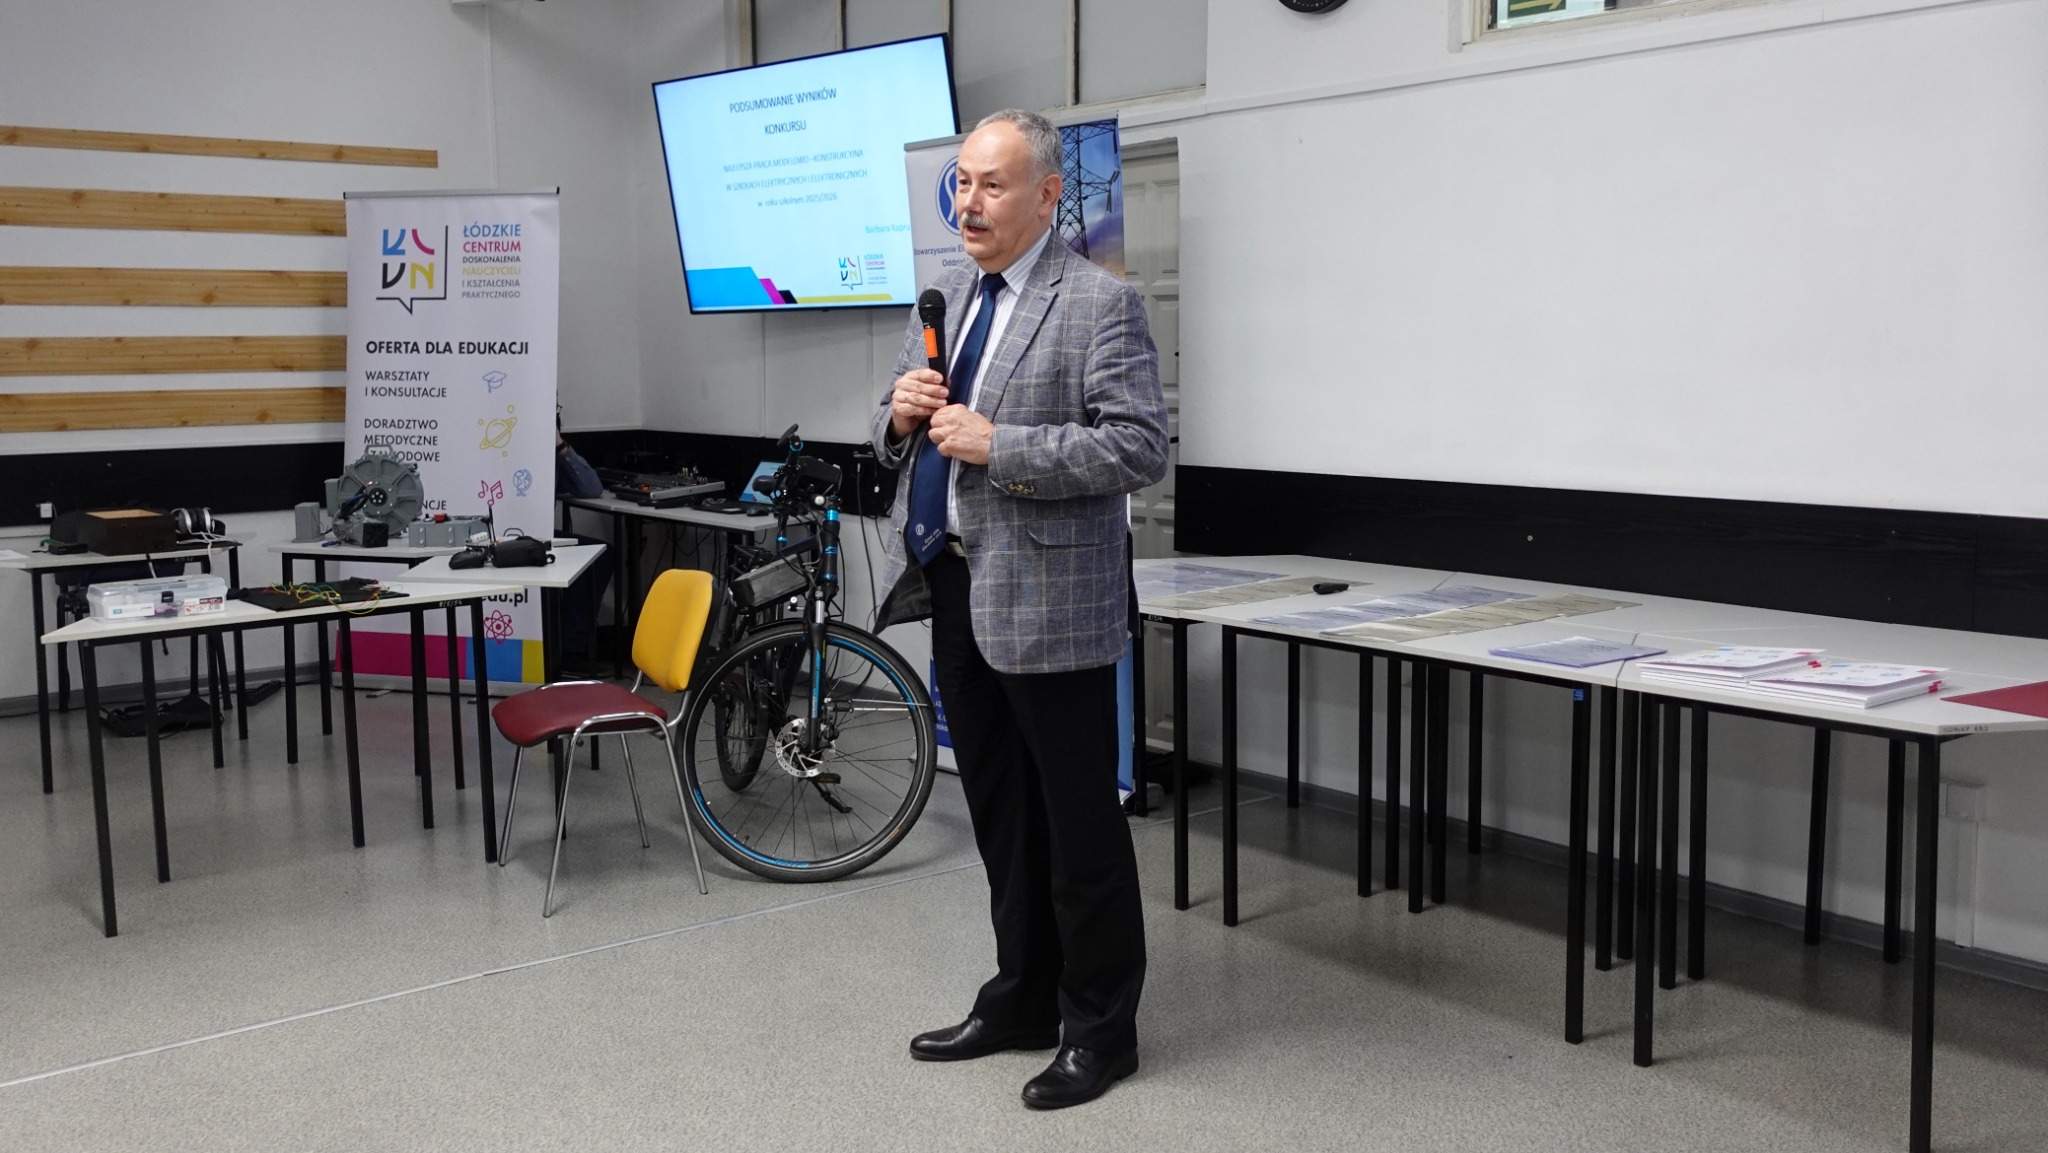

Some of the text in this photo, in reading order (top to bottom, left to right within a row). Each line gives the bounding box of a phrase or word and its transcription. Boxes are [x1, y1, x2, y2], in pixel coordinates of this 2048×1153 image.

[729, 86, 837, 113] PODSUMOWANIE WYNIKÓW
[764, 120, 807, 135] KONKURSU
[753, 159, 772, 170] PRACA
[773, 155, 809, 167] MODELOWO
[761, 175, 807, 188] ELEKTRYCZNYCH
[810, 169, 868, 183] ELEKTRONICZNYCH
[765, 197, 778, 207] roku
[779, 195, 804, 207] szkolnym
[463, 221, 521, 238] ŁÓDZKIE
[865, 223, 890, 234] Barbara
[463, 240, 521, 253] CENTRUM
[462, 255, 521, 264] DOSKONALENIA
[462, 266, 521, 276] NAUCZYCIELI
[466, 279, 520, 288] KSZTAŁCENIA
[462, 290, 521, 299] PRAKTYCZNEGO
[366, 341, 529, 355] OFERTA DLA EDUKACJI
[365, 370, 430, 381] WARSZTATY
[371, 387, 447, 398] KONSULTACJE
[364, 418, 438, 430] DORADZTWO
[364, 434, 438, 446] METODYCZNE
